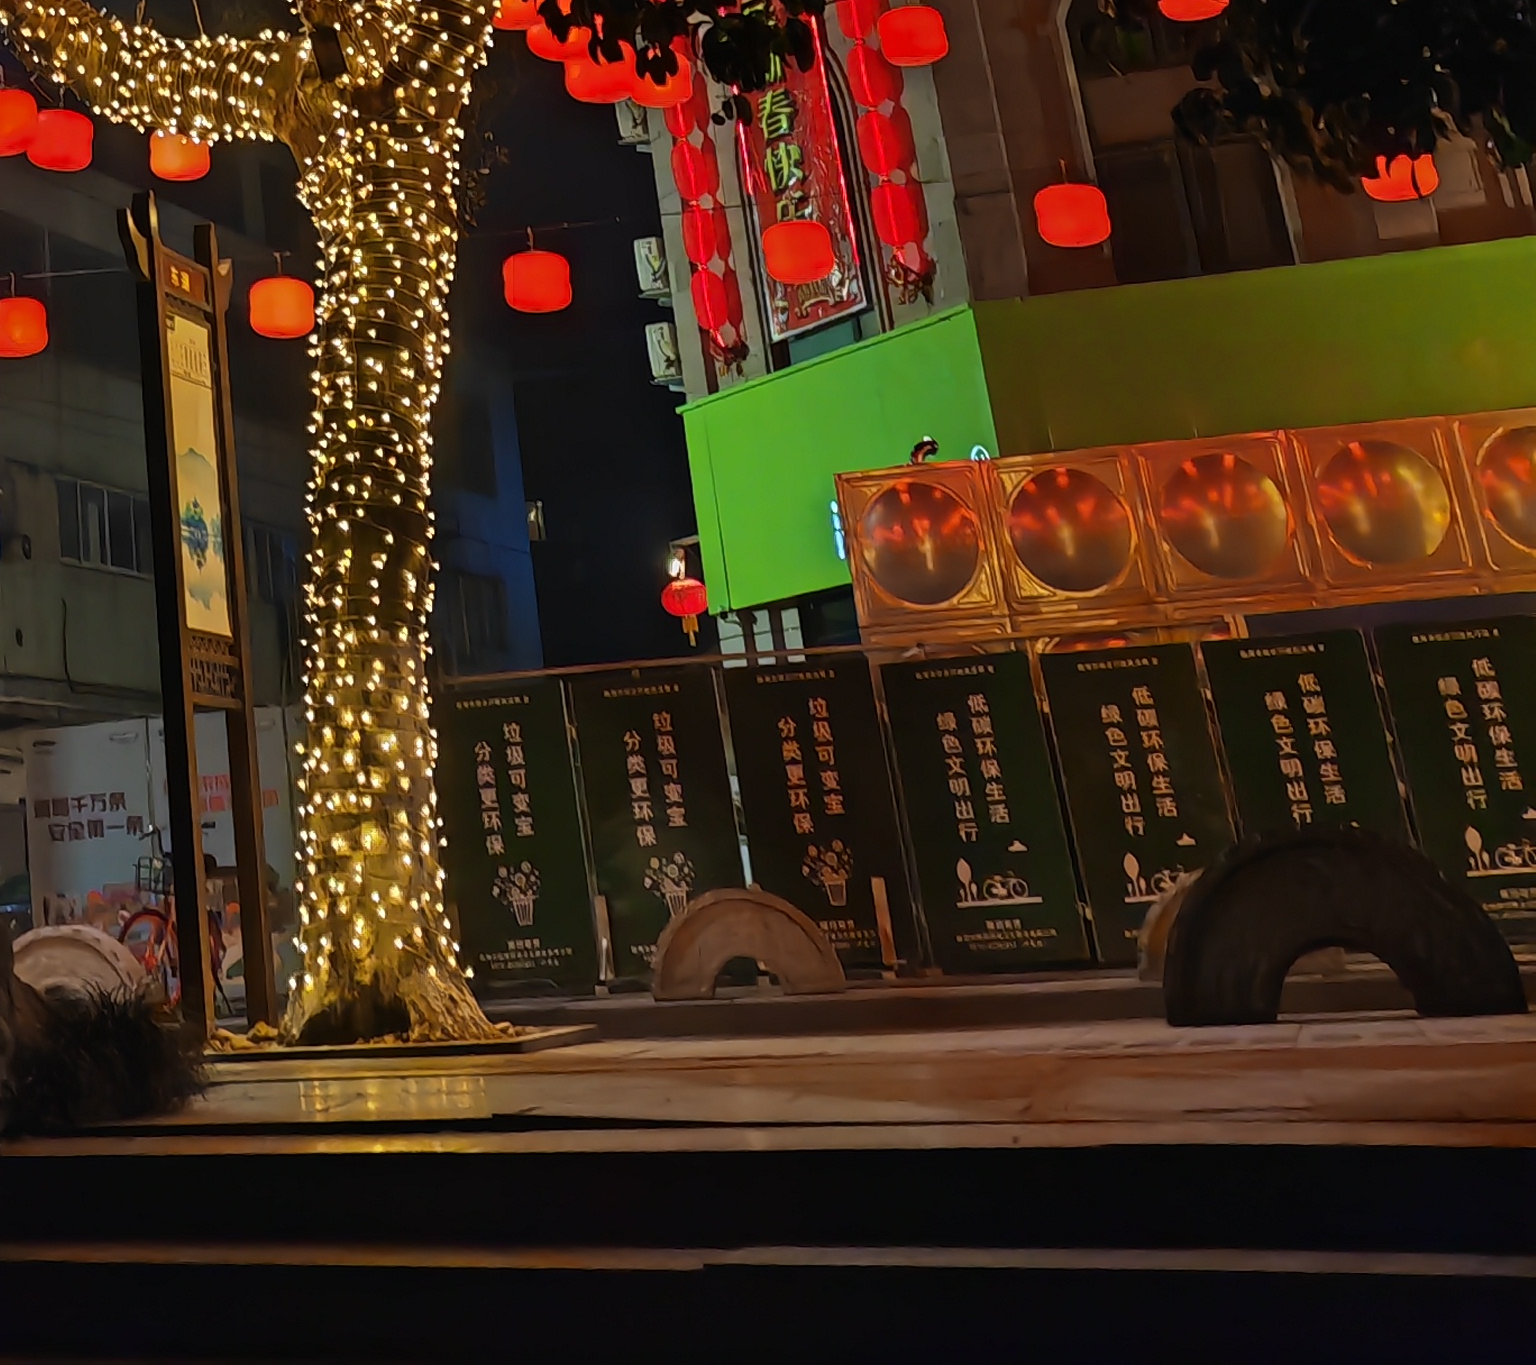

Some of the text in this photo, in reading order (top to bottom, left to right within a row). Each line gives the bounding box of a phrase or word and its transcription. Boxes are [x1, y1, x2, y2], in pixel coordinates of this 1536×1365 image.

[502, 721, 535, 837] 垃圾可变宝
[622, 729, 657, 847] 分类更环保
[652, 710, 687, 827] 垃圾可变宝
[776, 715, 815, 835] 分类更环保
[807, 696, 845, 816] 垃圾可变宝
[935, 710, 980, 843] 绿色文明出行
[967, 692, 1011, 824] 低碳环保生活
[1099, 704, 1146, 837] 绿色文明出行
[1131, 685, 1178, 818] 低碳环保生活
[1264, 690, 1314, 831] 绿色文明出行
[1297, 672, 1347, 805] 低碳环保生活
[1437, 676, 1488, 810] 绿色文明出行
[1471, 657, 1524, 791] 低碳环保生活
[473, 740, 506, 857] 分类更环保
